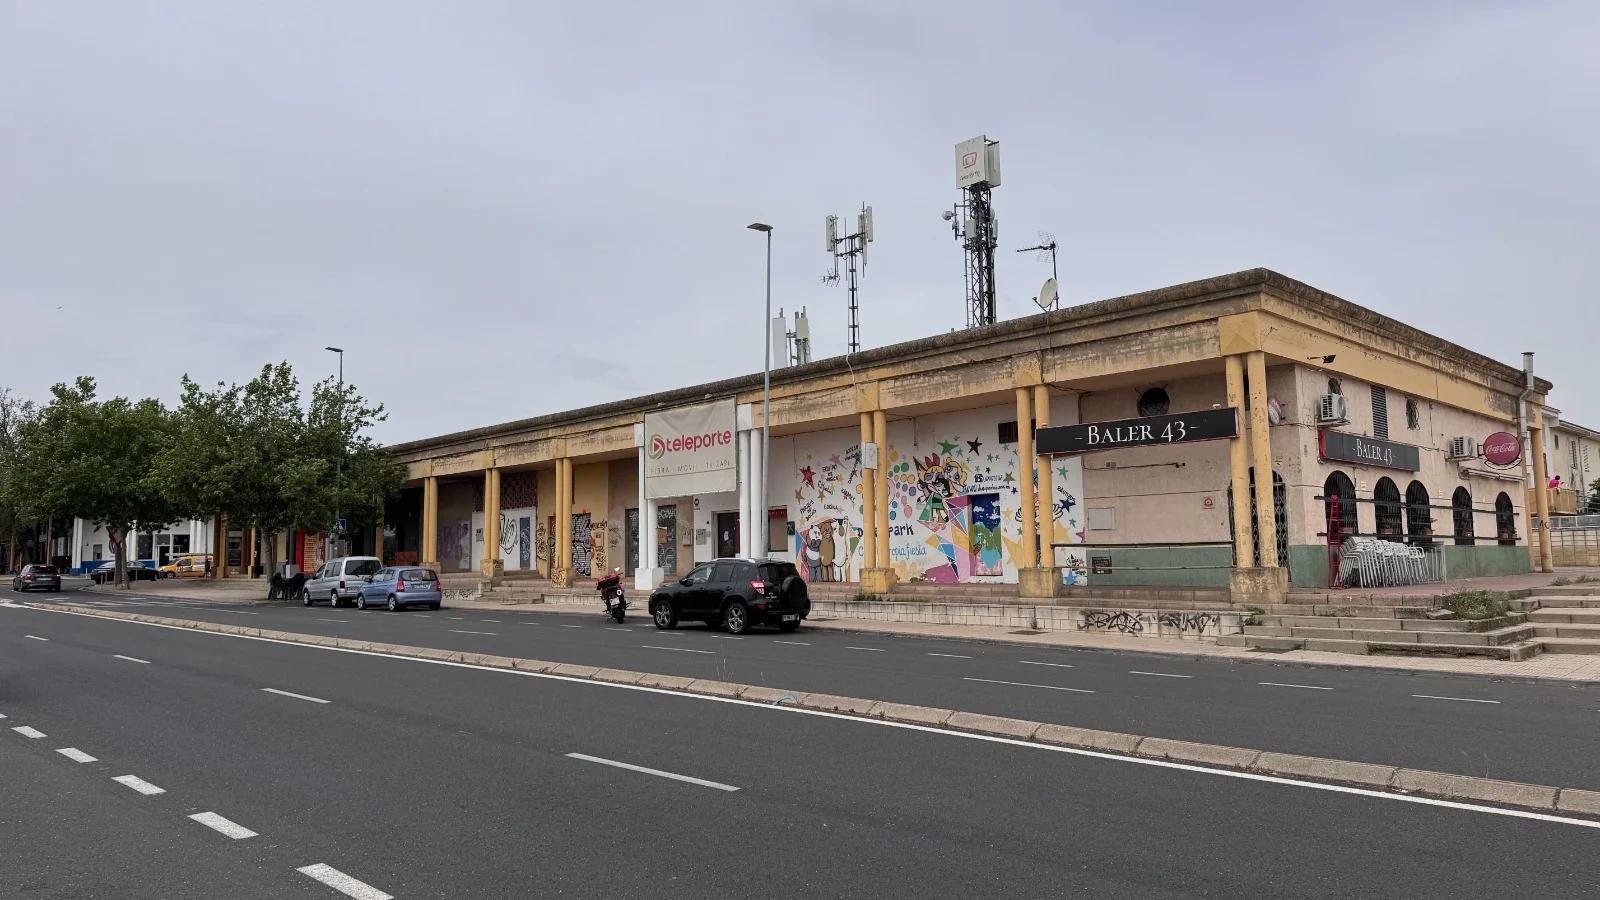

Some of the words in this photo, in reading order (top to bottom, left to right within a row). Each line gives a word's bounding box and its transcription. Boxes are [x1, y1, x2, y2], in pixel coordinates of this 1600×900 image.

[666, 430, 732, 453] teleporte
[1087, 425, 1156, 445] BALER
[1161, 420, 1187, 443] 43
[1356, 438, 1383, 461] BALER
[1383, 447, 1393, 466] 43
[1485, 441, 1517, 455] Coca-Cola
[650, 466, 670, 475] FIBRA
[677, 463, 699, 473] MOVI
